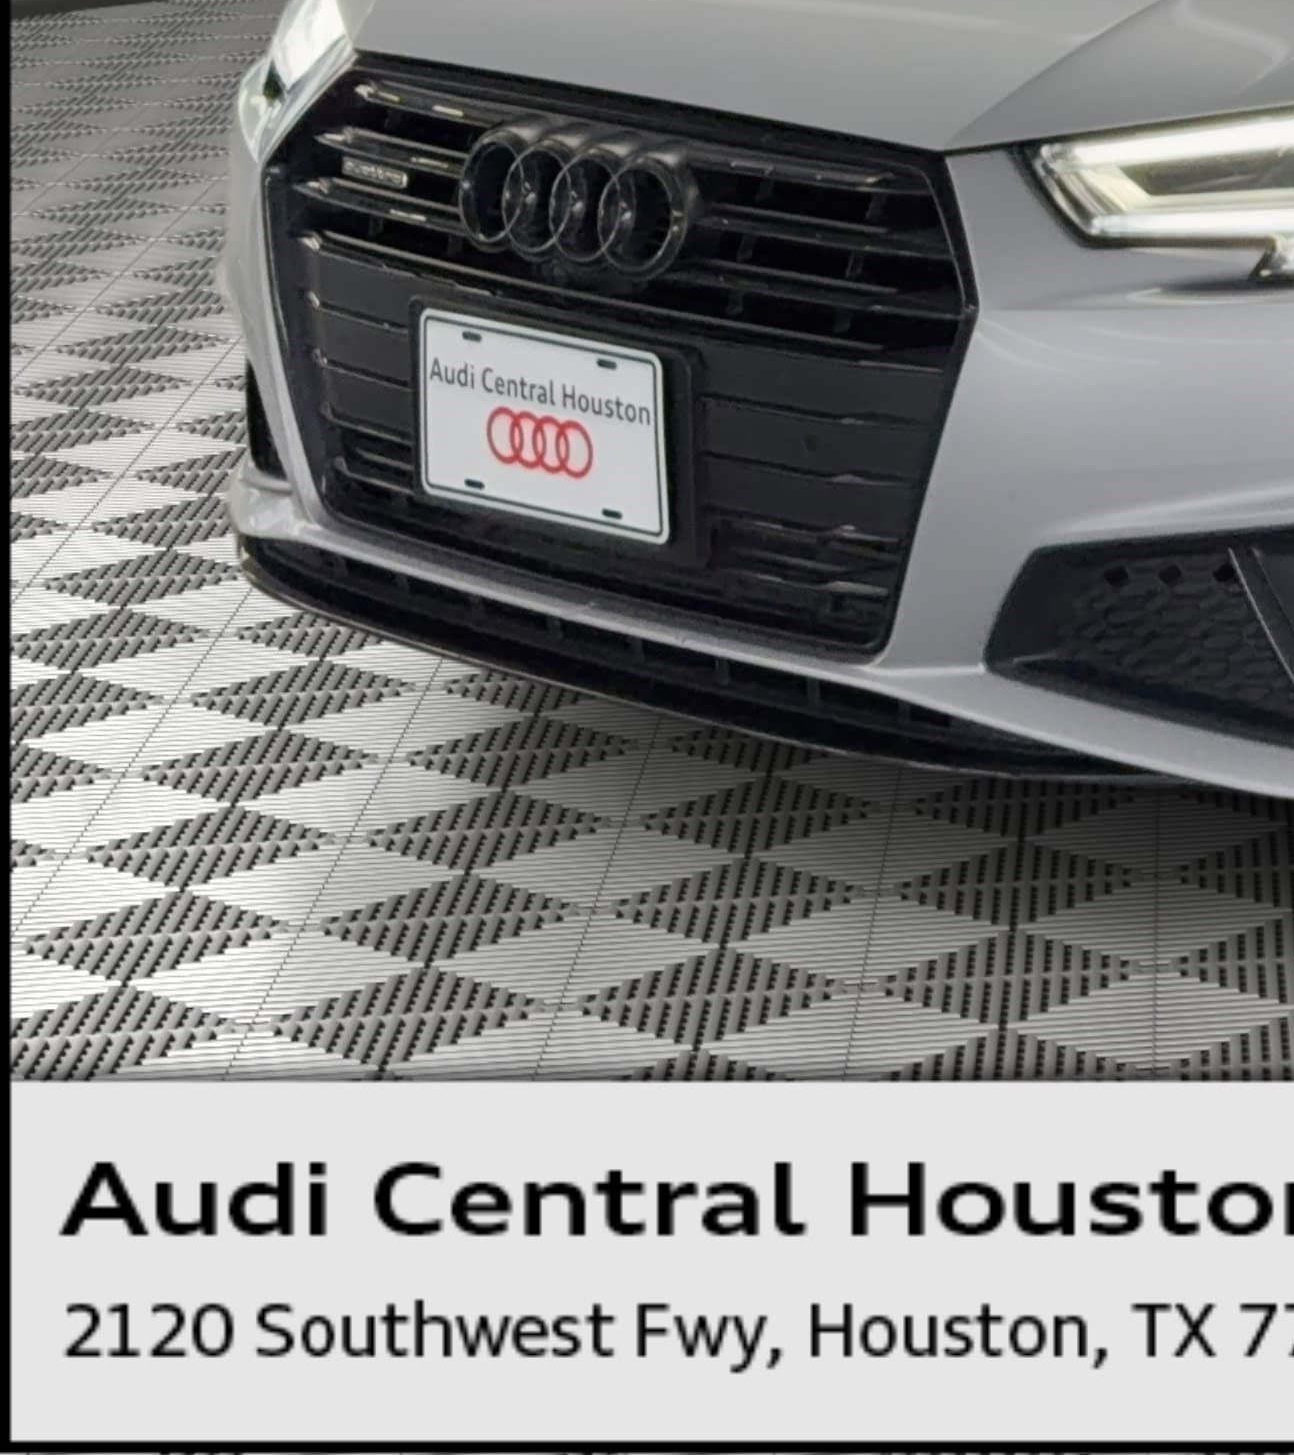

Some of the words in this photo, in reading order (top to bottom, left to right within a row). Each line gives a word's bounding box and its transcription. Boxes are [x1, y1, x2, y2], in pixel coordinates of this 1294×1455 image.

[430, 357, 475, 389] Audi
[482, 368, 555, 406] Central
[562, 385, 651, 425] Houston
